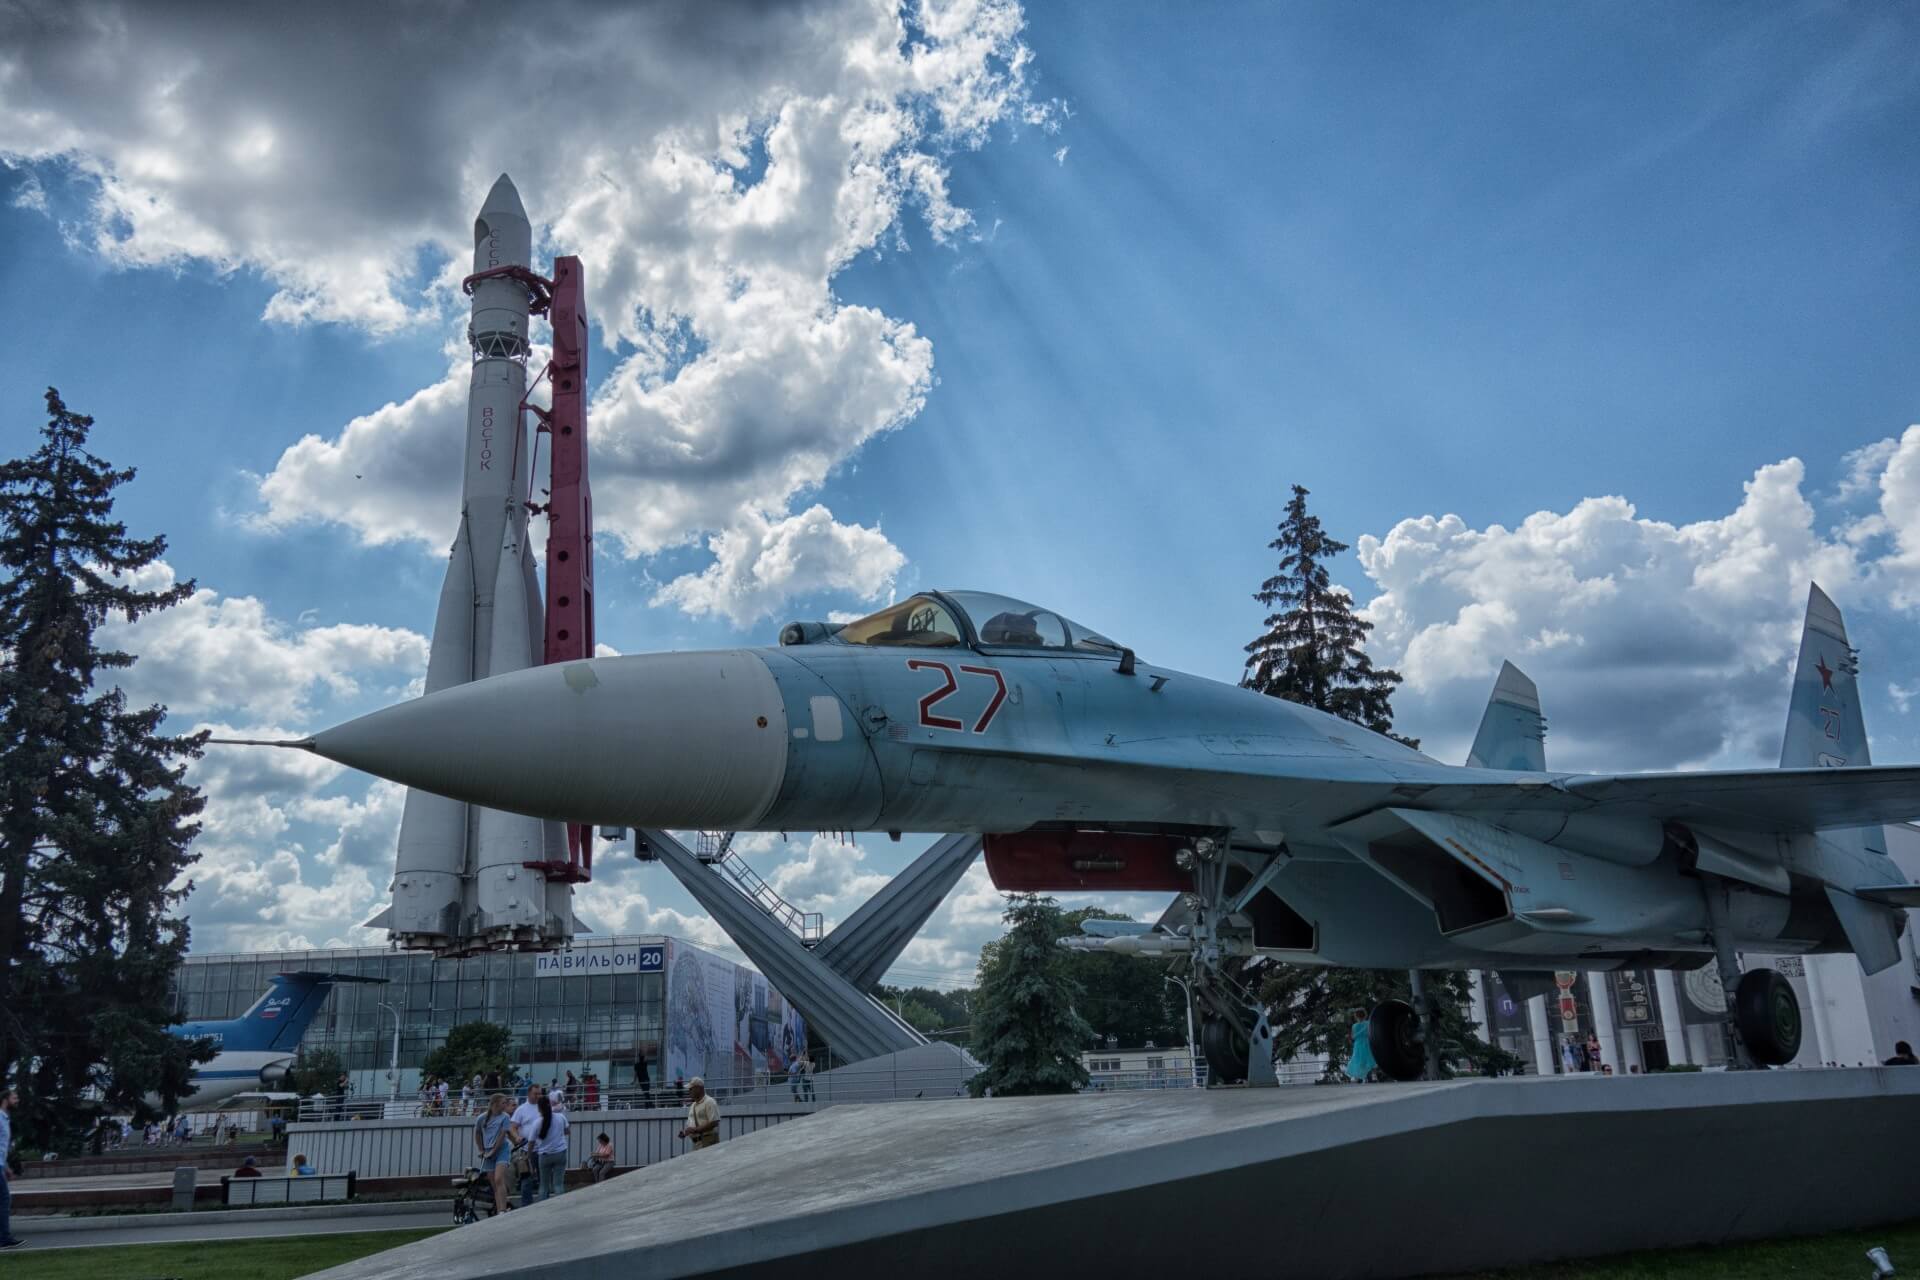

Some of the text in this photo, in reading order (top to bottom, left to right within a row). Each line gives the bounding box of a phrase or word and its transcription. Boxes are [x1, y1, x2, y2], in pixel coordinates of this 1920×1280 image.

[481, 407, 493, 470] ВОСТОК
[906, 659, 1008, 734] 27
[538, 952, 661, 970] ПАВИЛЬОН 20
